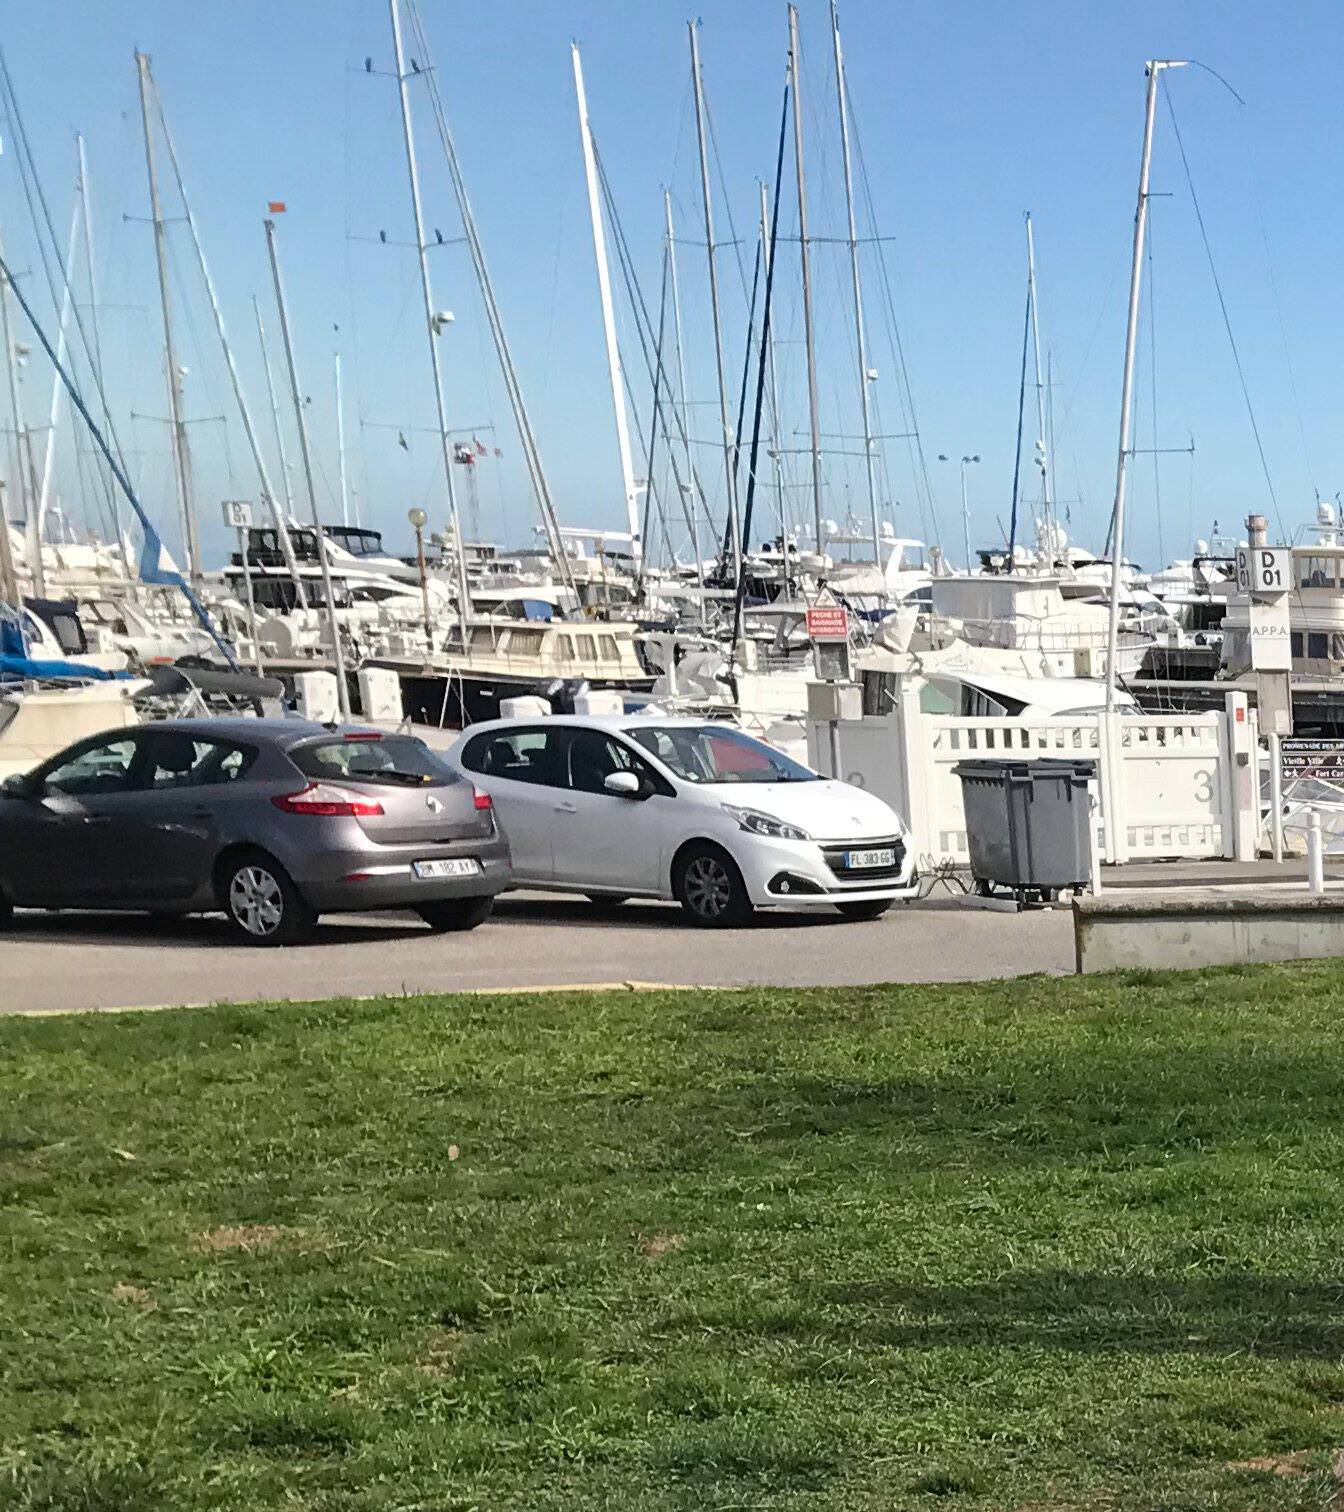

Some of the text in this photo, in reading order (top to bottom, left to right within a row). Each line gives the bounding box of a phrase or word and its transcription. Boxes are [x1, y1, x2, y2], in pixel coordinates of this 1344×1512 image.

[1239, 551, 1247, 569] D
[1261, 551, 1275, 569] D
[1240, 569, 1250, 587] 01
[1262, 569, 1282, 586] 01
[1193, 769, 1214, 803] 3
